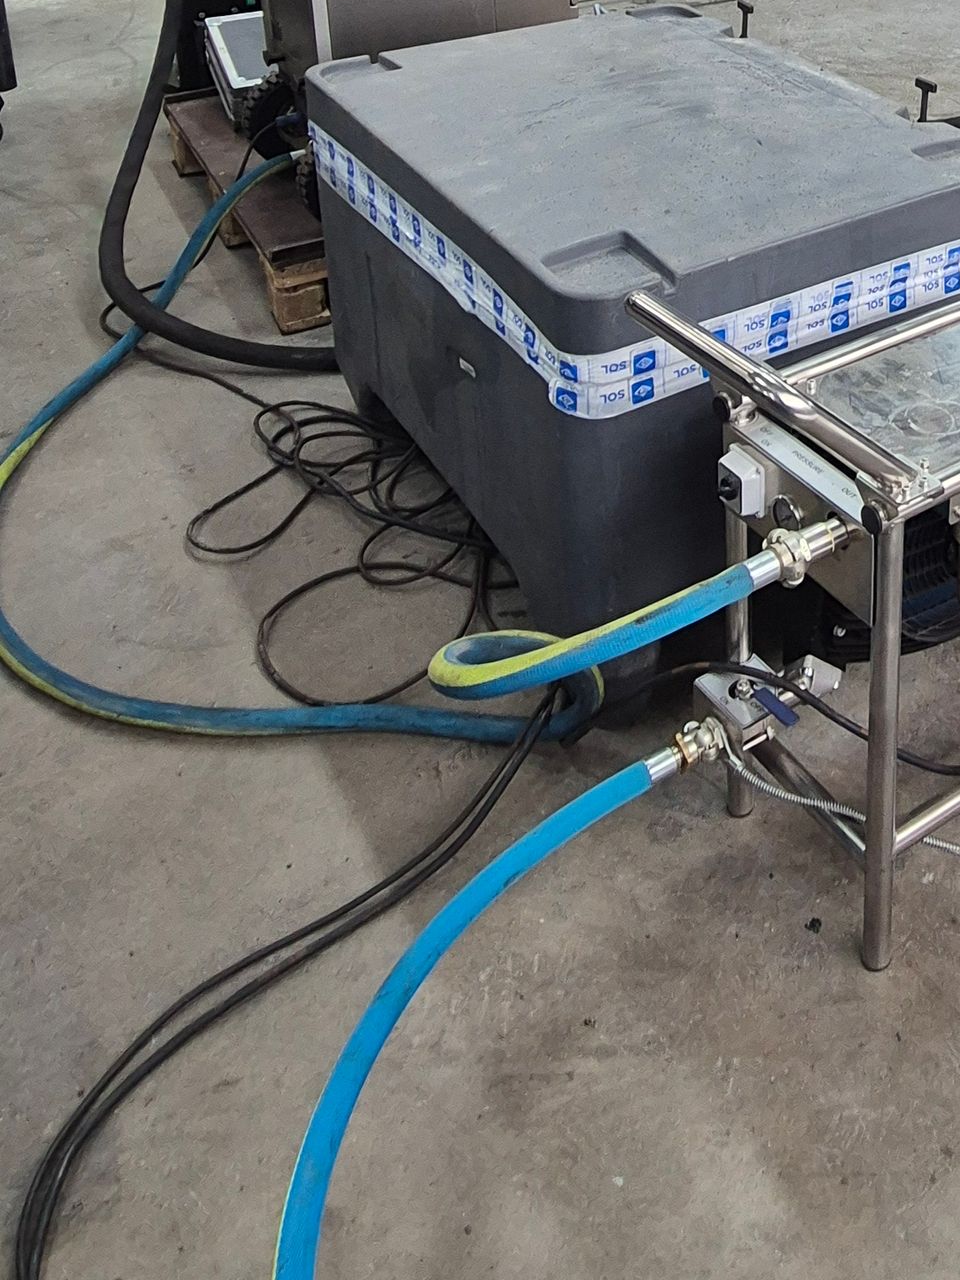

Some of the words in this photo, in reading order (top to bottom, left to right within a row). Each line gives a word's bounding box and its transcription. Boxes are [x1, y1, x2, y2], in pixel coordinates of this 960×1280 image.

[926, 254, 944, 265] SOL
[867, 284, 885, 295] SOL
[922, 280, 939, 292] SOL
[808, 301, 827, 313] SOL
[865, 297, 884, 310] SOL
[744, 318, 765, 332] SOL
[806, 318, 825, 330] SOL
[742, 340, 762, 352] SOL
[601, 359, 627, 374] SOL
[673, 363, 697, 379] SOL
[600, 388, 625, 404] SOL
[841, 486, 857, 499] OUT
